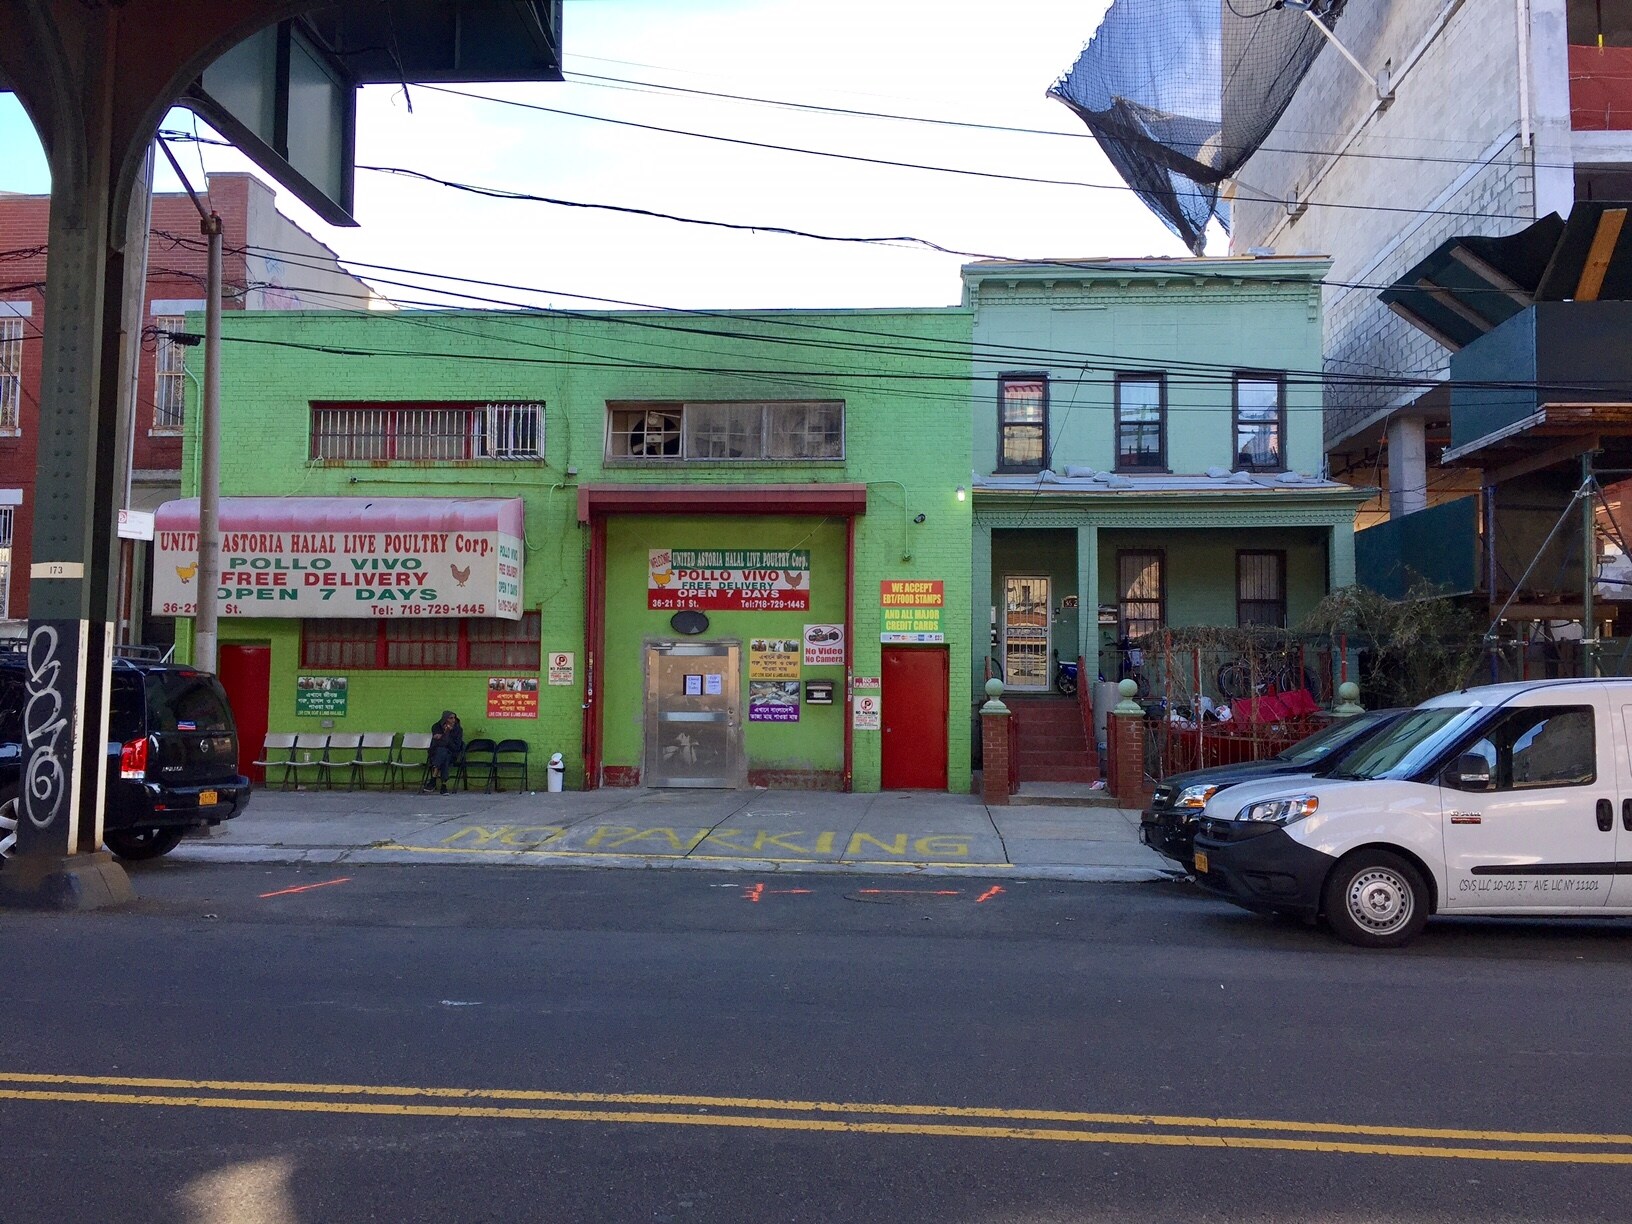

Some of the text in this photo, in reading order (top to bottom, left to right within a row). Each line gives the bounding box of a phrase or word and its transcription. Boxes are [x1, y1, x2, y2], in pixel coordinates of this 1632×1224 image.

[160, 532, 494, 557] UNIT ASTORIA HALAL LIVE POULTRY Corp.
[229, 557, 422, 570] POLLO VIVO
[672, 551, 809, 570] UNITED ASTORIA HALAL LIVE POULTRY Corp.
[49, 566, 63, 574] 173
[677, 569, 780, 582] POLLO VIVO
[220, 572, 429, 586] FREE DELIVERY
[681, 581, 774, 590] FREE DELIVERY
[891, 583, 933, 593] WE ACCEPT
[217, 587, 438, 601] OPEN 7 DAYS
[677, 589, 780, 598] OPEN 7 DAYS
[882, 594, 942, 604] EBT/FOOD STAMPS
[162, 603, 242, 615] 36-21 St.
[652, 599, 700, 608] 36-21 31 St.
[371, 605, 394, 616] Tel:
[400, 604, 486, 615] 718-729-1445
[884, 609, 940, 620] AND ALL MAJOR
[885, 620, 939, 631] CREDIT CARDS
[805, 647, 843, 655] No Video
[805, 655, 843, 663] No Camera
[441, 824, 974, 857] NO PARKING
[1478, 879, 1492, 891] LLC
[1493, 880, 1516, 891] 10-01
[1534, 879, 1549, 891] AVE
[1564, 879, 1575, 891] NY
[1575, 880, 1600, 891] 11101
